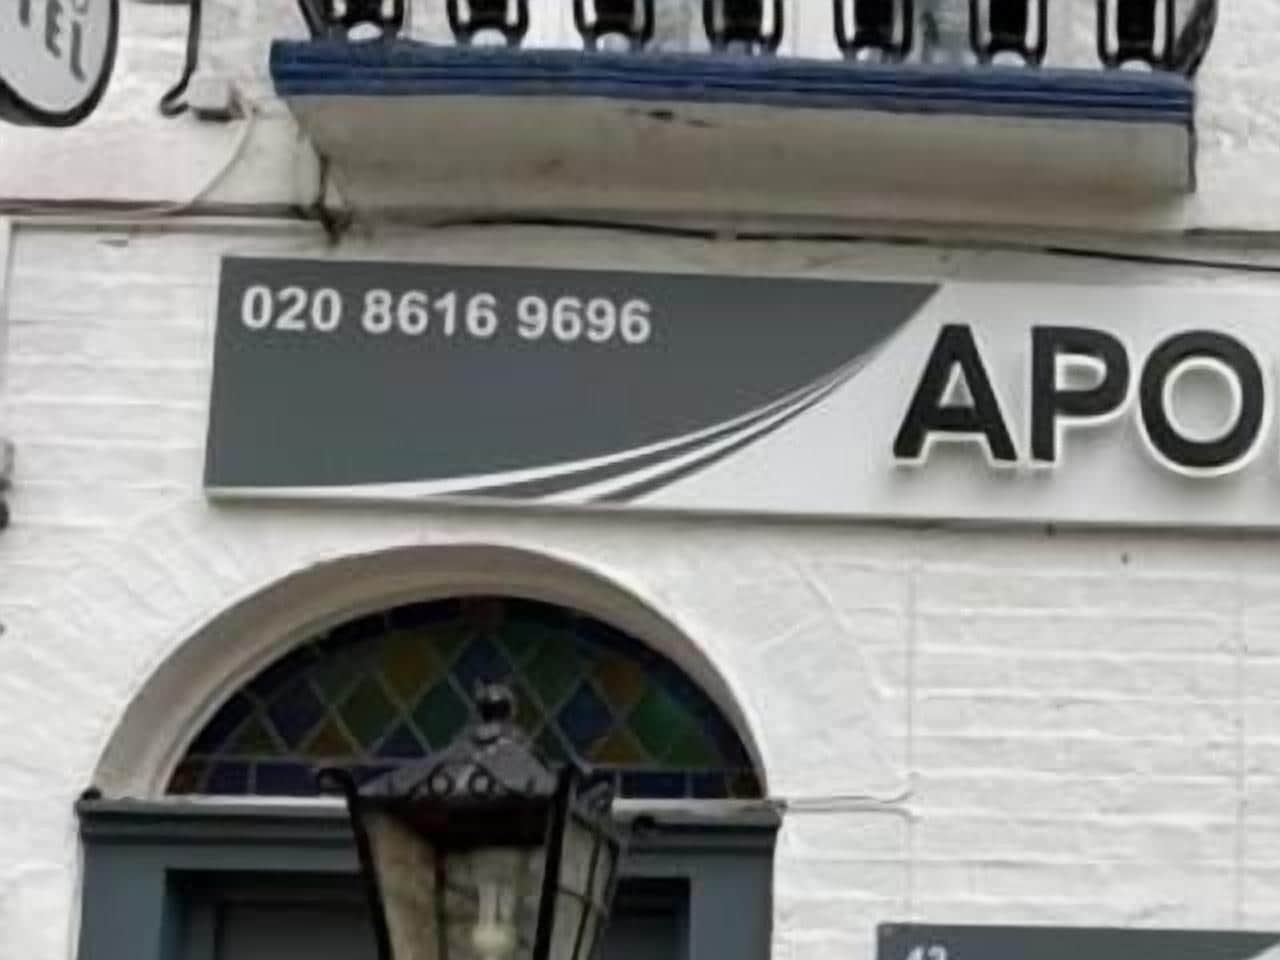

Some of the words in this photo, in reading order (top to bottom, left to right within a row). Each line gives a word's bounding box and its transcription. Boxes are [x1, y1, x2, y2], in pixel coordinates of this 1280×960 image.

[240, 284, 342, 332] 020
[361, 289, 498, 338] 8616
[516, 295, 652, 344] 9696
